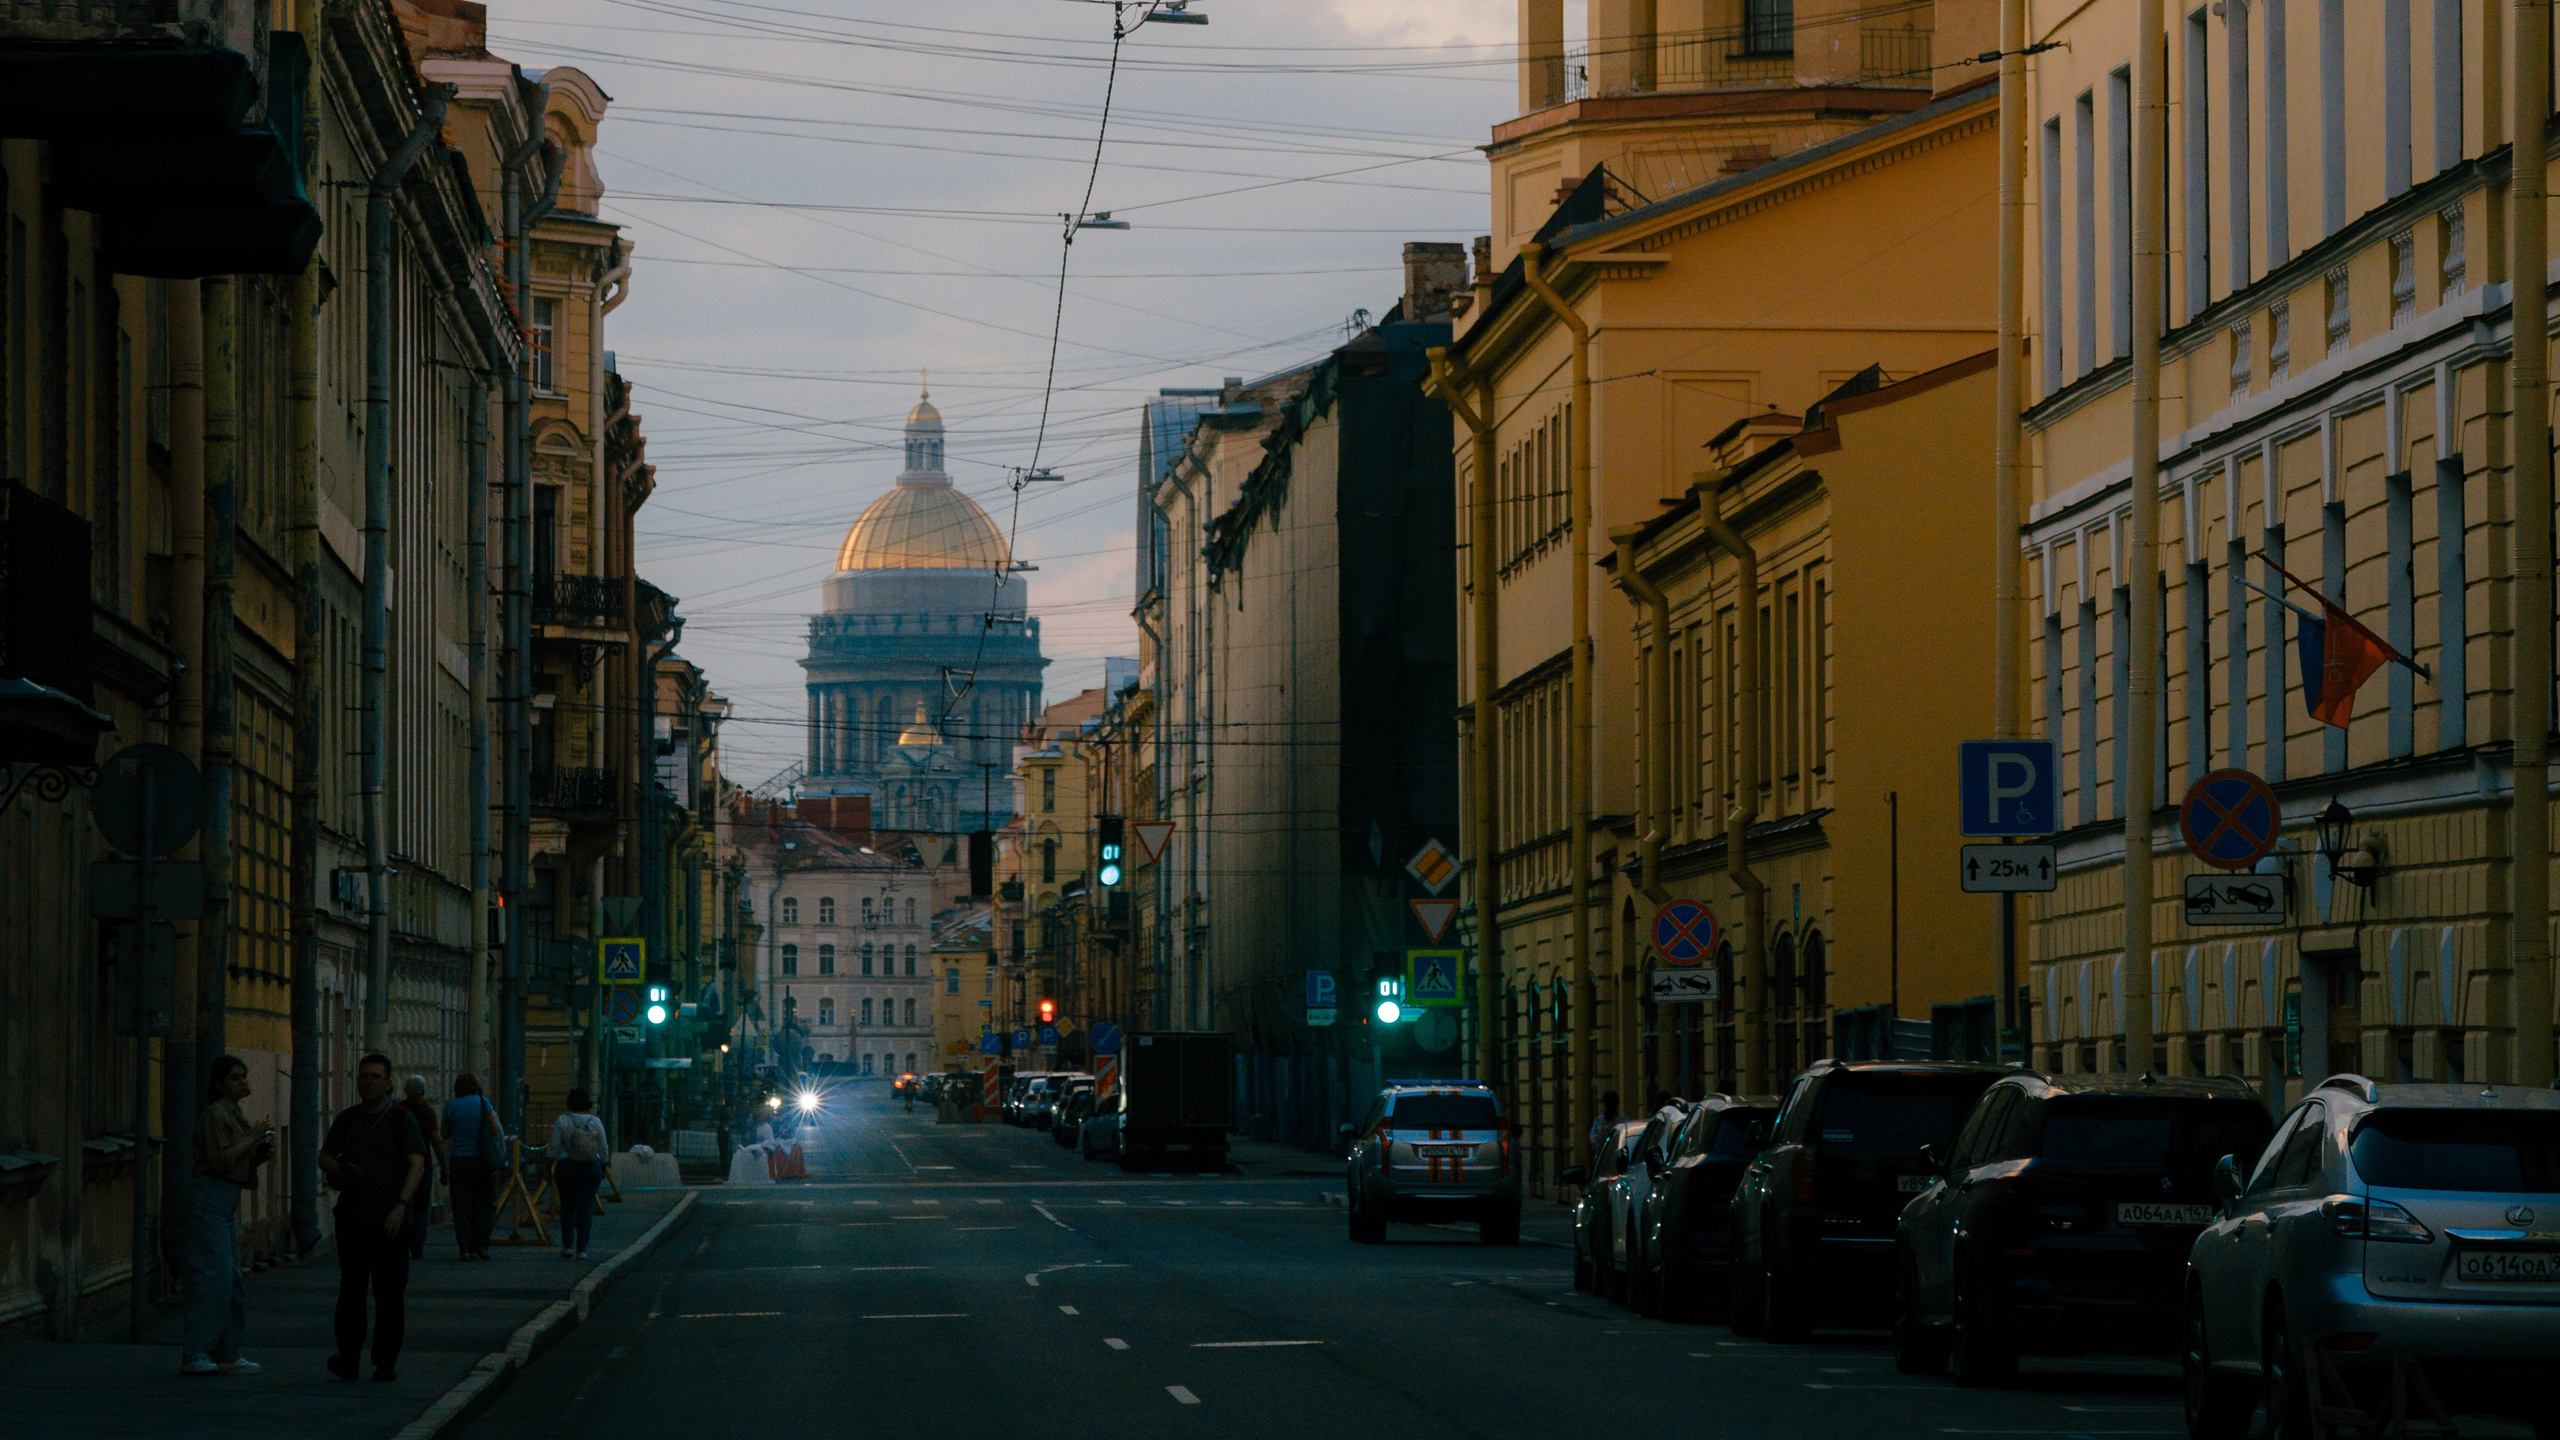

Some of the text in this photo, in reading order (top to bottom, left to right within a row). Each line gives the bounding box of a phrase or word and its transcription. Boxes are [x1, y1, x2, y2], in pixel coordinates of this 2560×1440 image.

[1987, 752, 2037, 824] P
[1317, 975, 1336, 1002] P
[1380, 981, 1398, 997] 01
[1017, 1031, 1028, 1045] P
[1043, 1028, 1054, 1043] P
[2467, 1254, 2547, 1275] О614ОА
